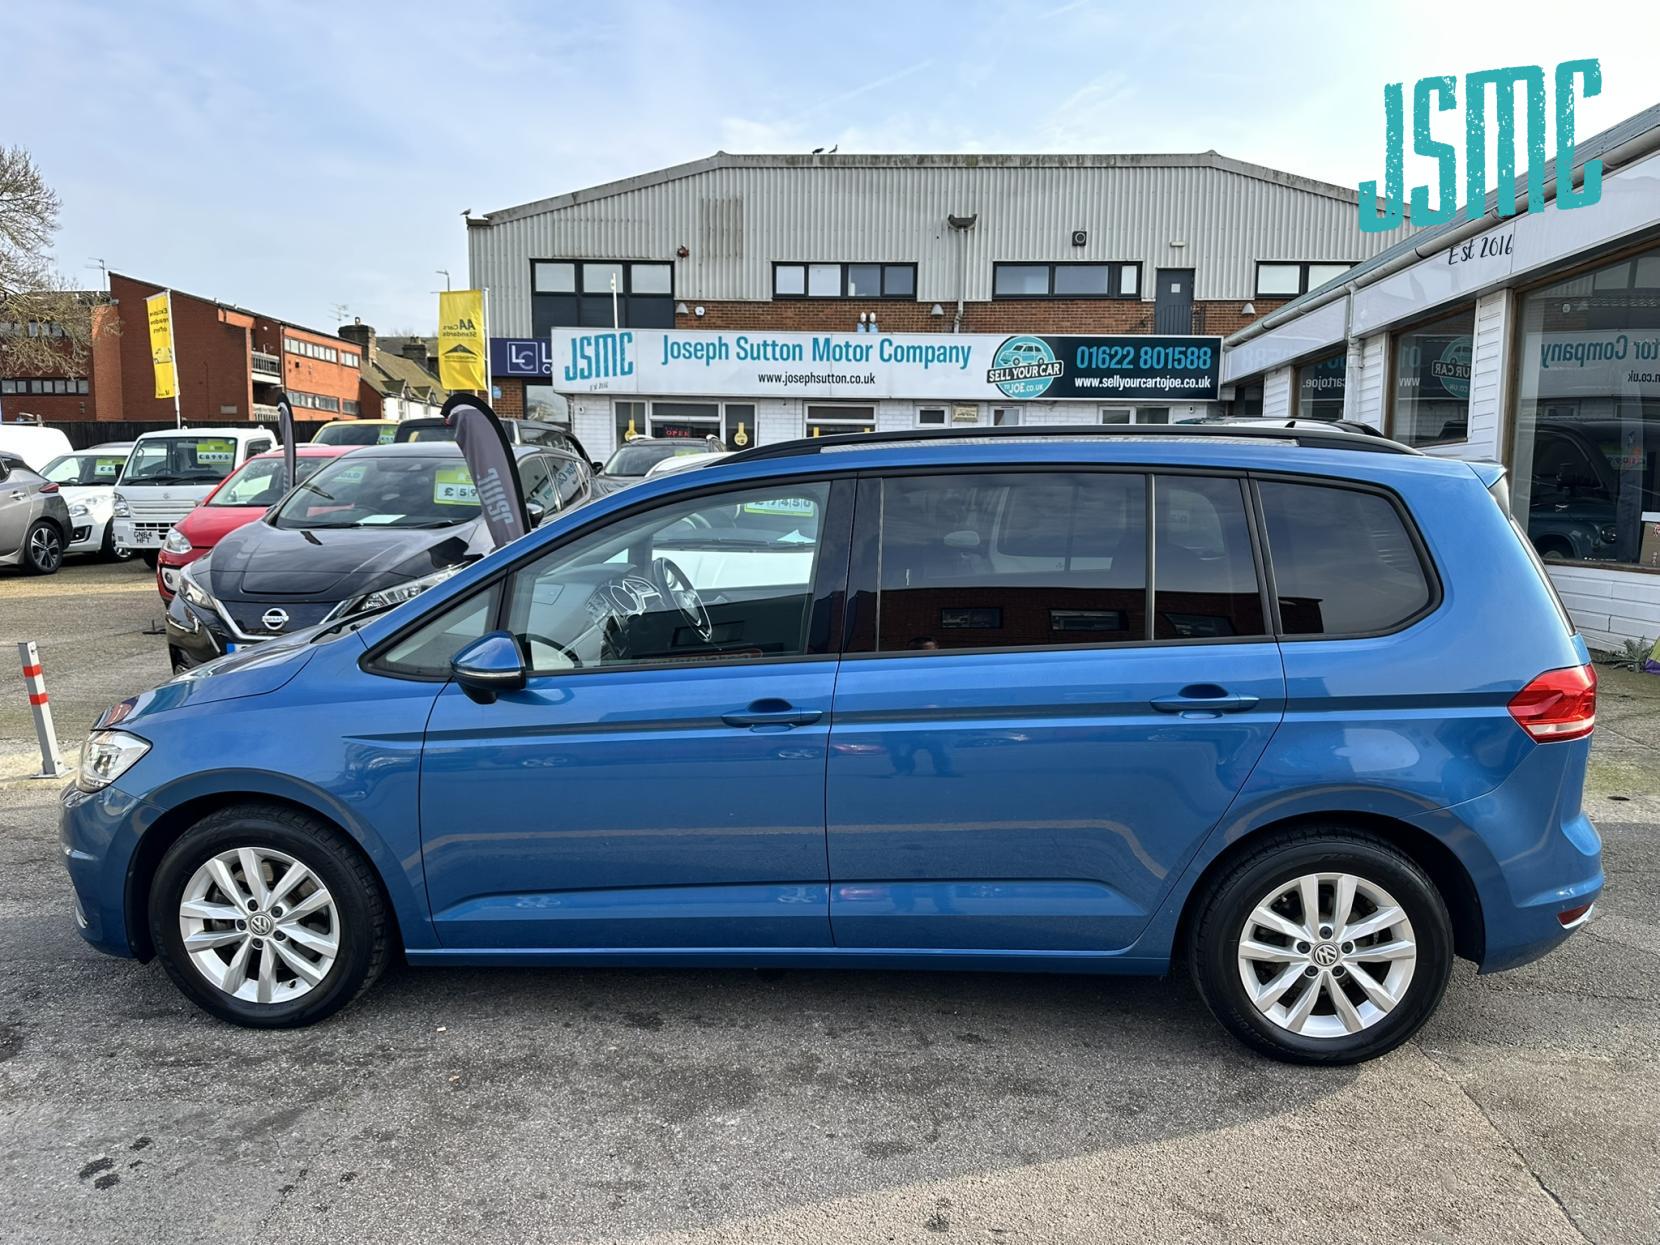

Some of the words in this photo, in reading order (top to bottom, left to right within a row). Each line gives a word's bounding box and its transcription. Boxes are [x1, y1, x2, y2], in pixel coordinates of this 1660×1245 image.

[564, 332, 634, 382] JSMC
[661, 334, 729, 367] Joseph
[735, 336, 803, 362] Sutton
[812, 337, 873, 363] Motor
[879, 338, 972, 370] Company
[1076, 345, 1134, 370] 01622
[1139, 346, 1212, 370] 801588
[758, 371, 876, 386] www.josephsutton.co.uk
[989, 368, 1011, 382] SELL
[1013, 365, 1039, 379] YOUR
[1040, 363, 1061, 377] CAR
[1074, 375, 1212, 391] www.sellyourcartojoe.co.uk
[444, 486, 478, 498] £59
